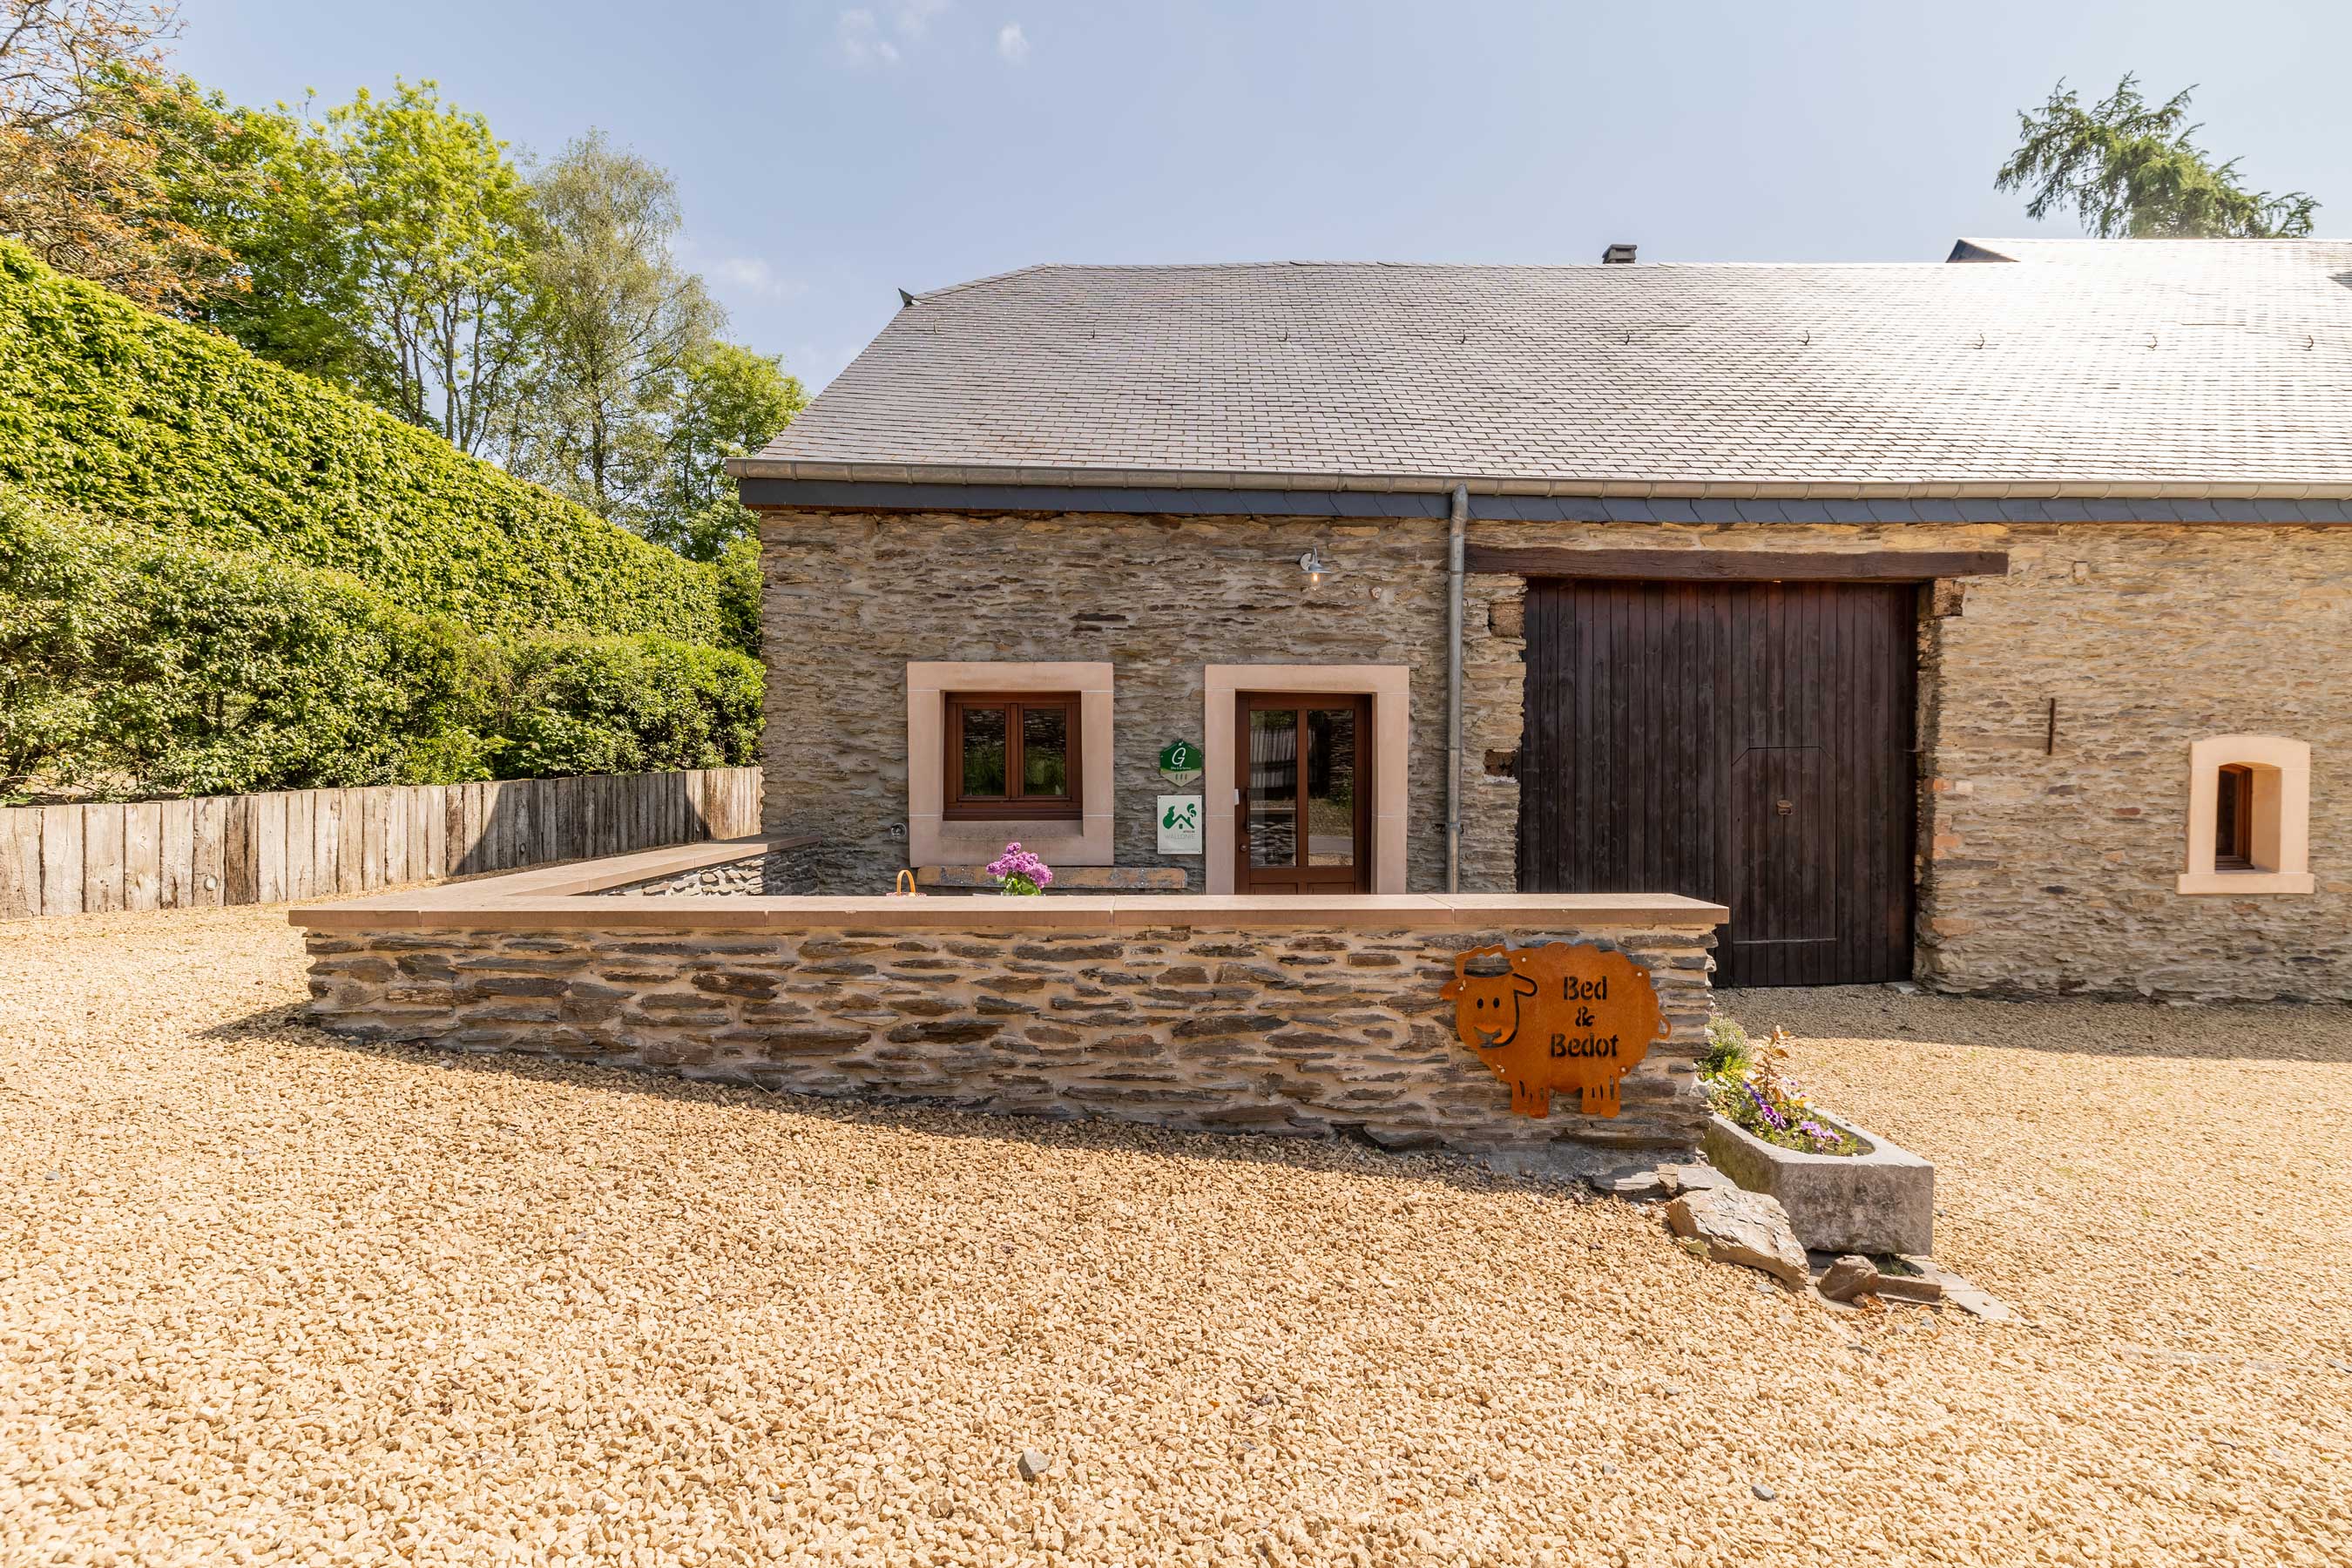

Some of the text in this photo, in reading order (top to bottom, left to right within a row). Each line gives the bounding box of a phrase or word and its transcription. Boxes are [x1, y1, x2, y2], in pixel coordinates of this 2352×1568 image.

[1563, 976, 1607, 1000] Bed
[1575, 1006, 1595, 1027] &
[1551, 1033, 1619, 1058] Bedot
